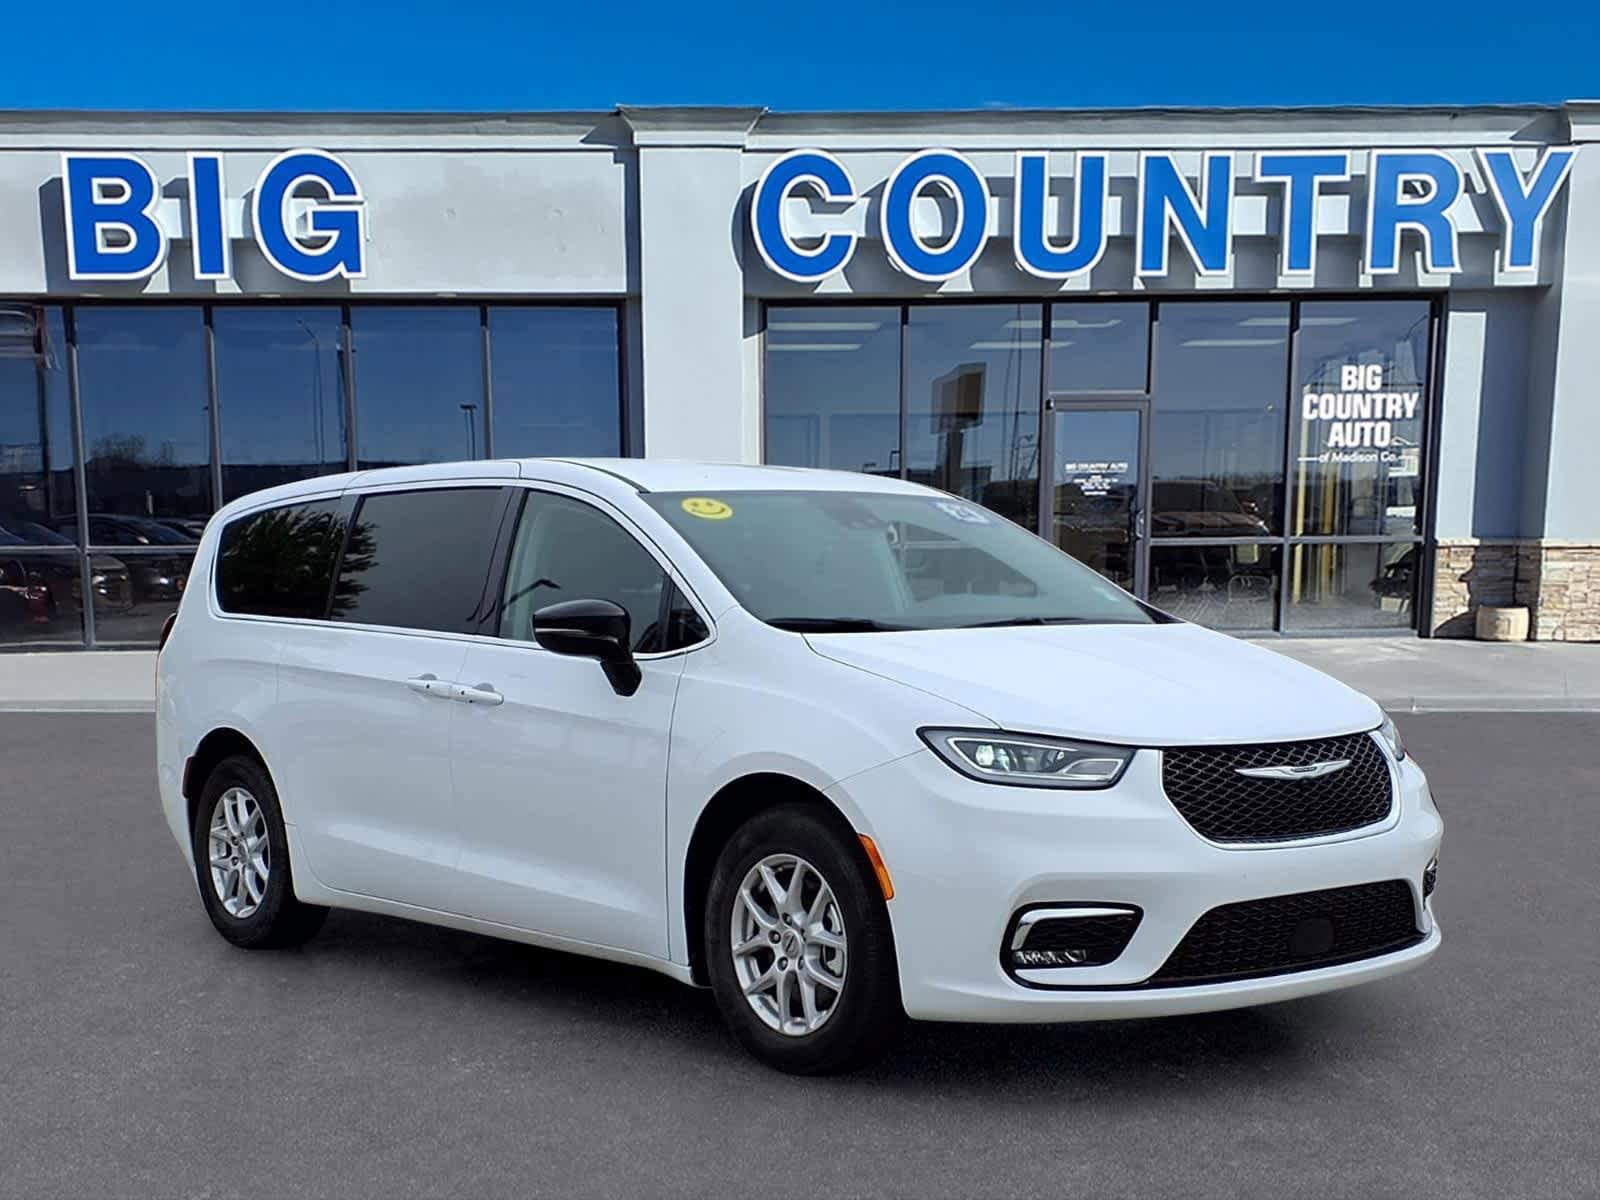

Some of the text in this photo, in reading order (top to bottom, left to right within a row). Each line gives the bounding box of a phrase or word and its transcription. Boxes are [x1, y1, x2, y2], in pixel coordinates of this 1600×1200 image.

[61, 148, 1575, 282] BIG COUNTRY
[1341, 365, 1383, 391] BIG
[1302, 393, 1419, 420] COUNTRY
[1328, 421, 1391, 448] AUTO
